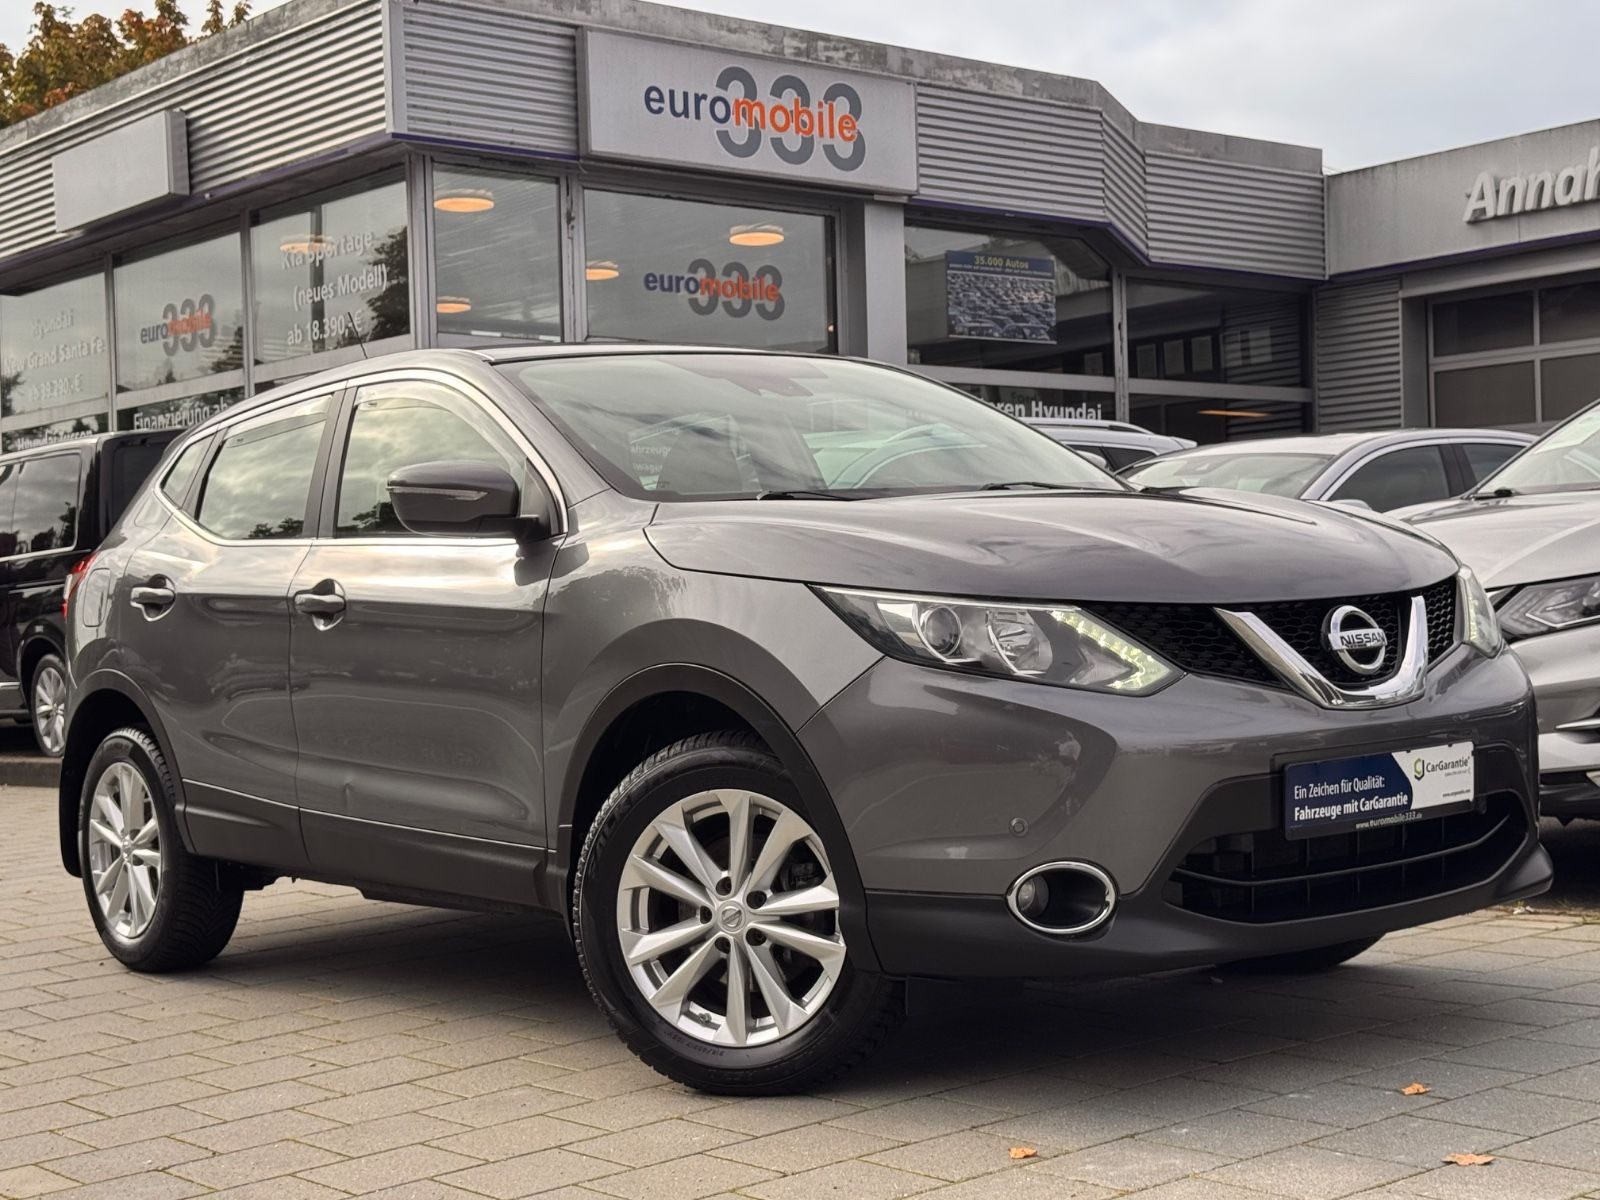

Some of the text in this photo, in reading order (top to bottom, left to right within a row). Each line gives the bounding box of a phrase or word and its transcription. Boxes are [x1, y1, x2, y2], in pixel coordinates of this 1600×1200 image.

[643, 84, 858, 143] euromobile
[974, 255, 1004, 267] 35.000
[1005, 258, 1030, 270] Autos
[293, 263, 387, 312] (neues Modell)
[644, 270, 780, 302] euromobile
[287, 323, 302, 345] ab
[59, 341, 89, 363] Santa
[1031, 400, 1102, 420] Hyundai
[1339, 632, 1386, 645] NISSAN
[1426, 757, 1469, 773] CarGarantie
[1294, 775, 1385, 800] Ein Zeichen für Qualität:
[1294, 791, 1408, 822] Fahrzeuge mit CarGarantie
